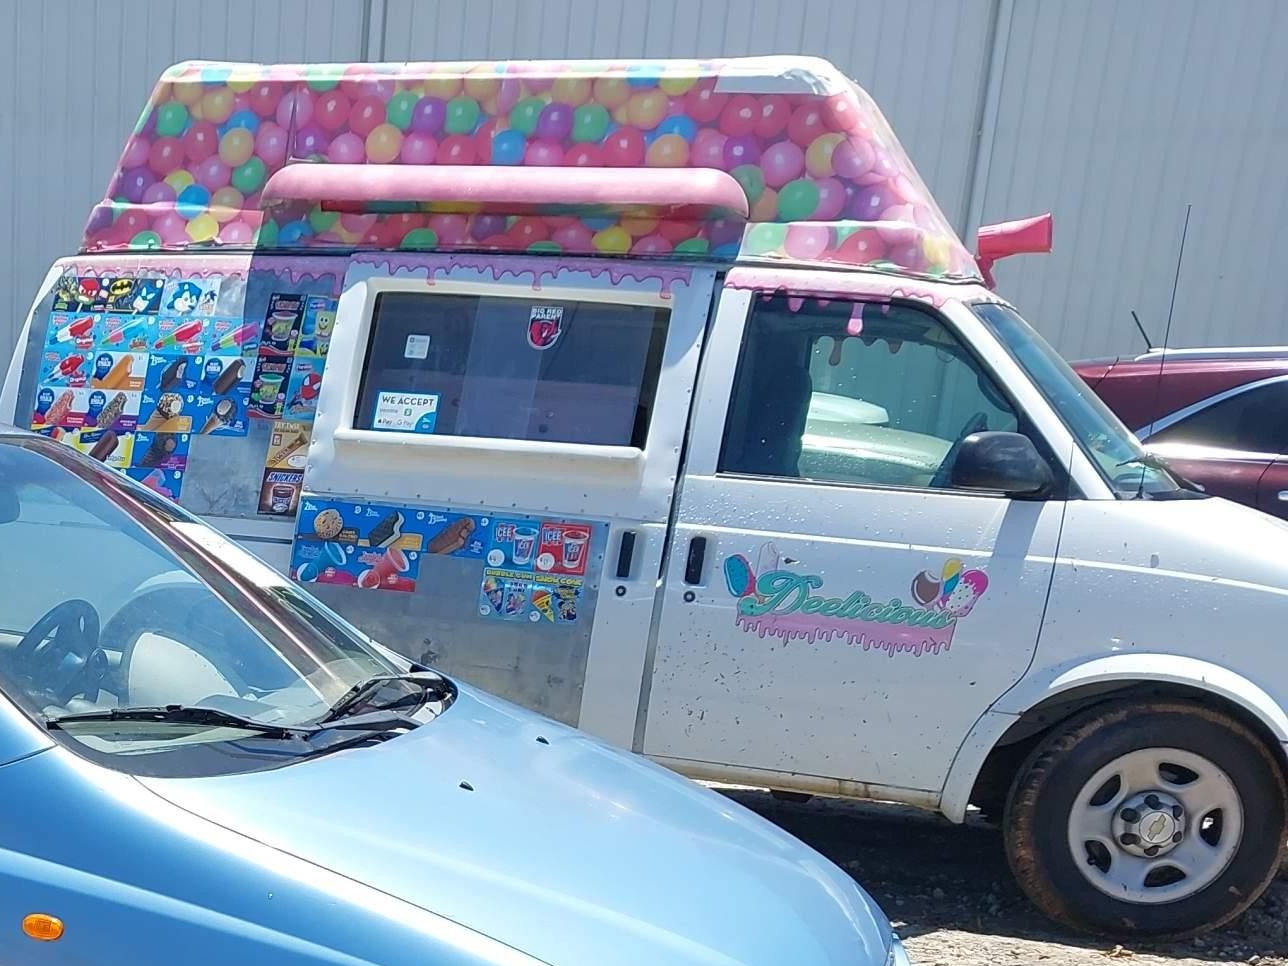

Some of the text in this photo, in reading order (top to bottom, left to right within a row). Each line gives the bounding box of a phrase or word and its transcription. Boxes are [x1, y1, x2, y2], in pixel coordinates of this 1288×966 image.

[382, 395, 434, 406] WE ACCEPT
[496, 527, 512, 537] ICEE
[544, 531, 561, 540] ICEE
[738, 570, 953, 628] Deelicious
